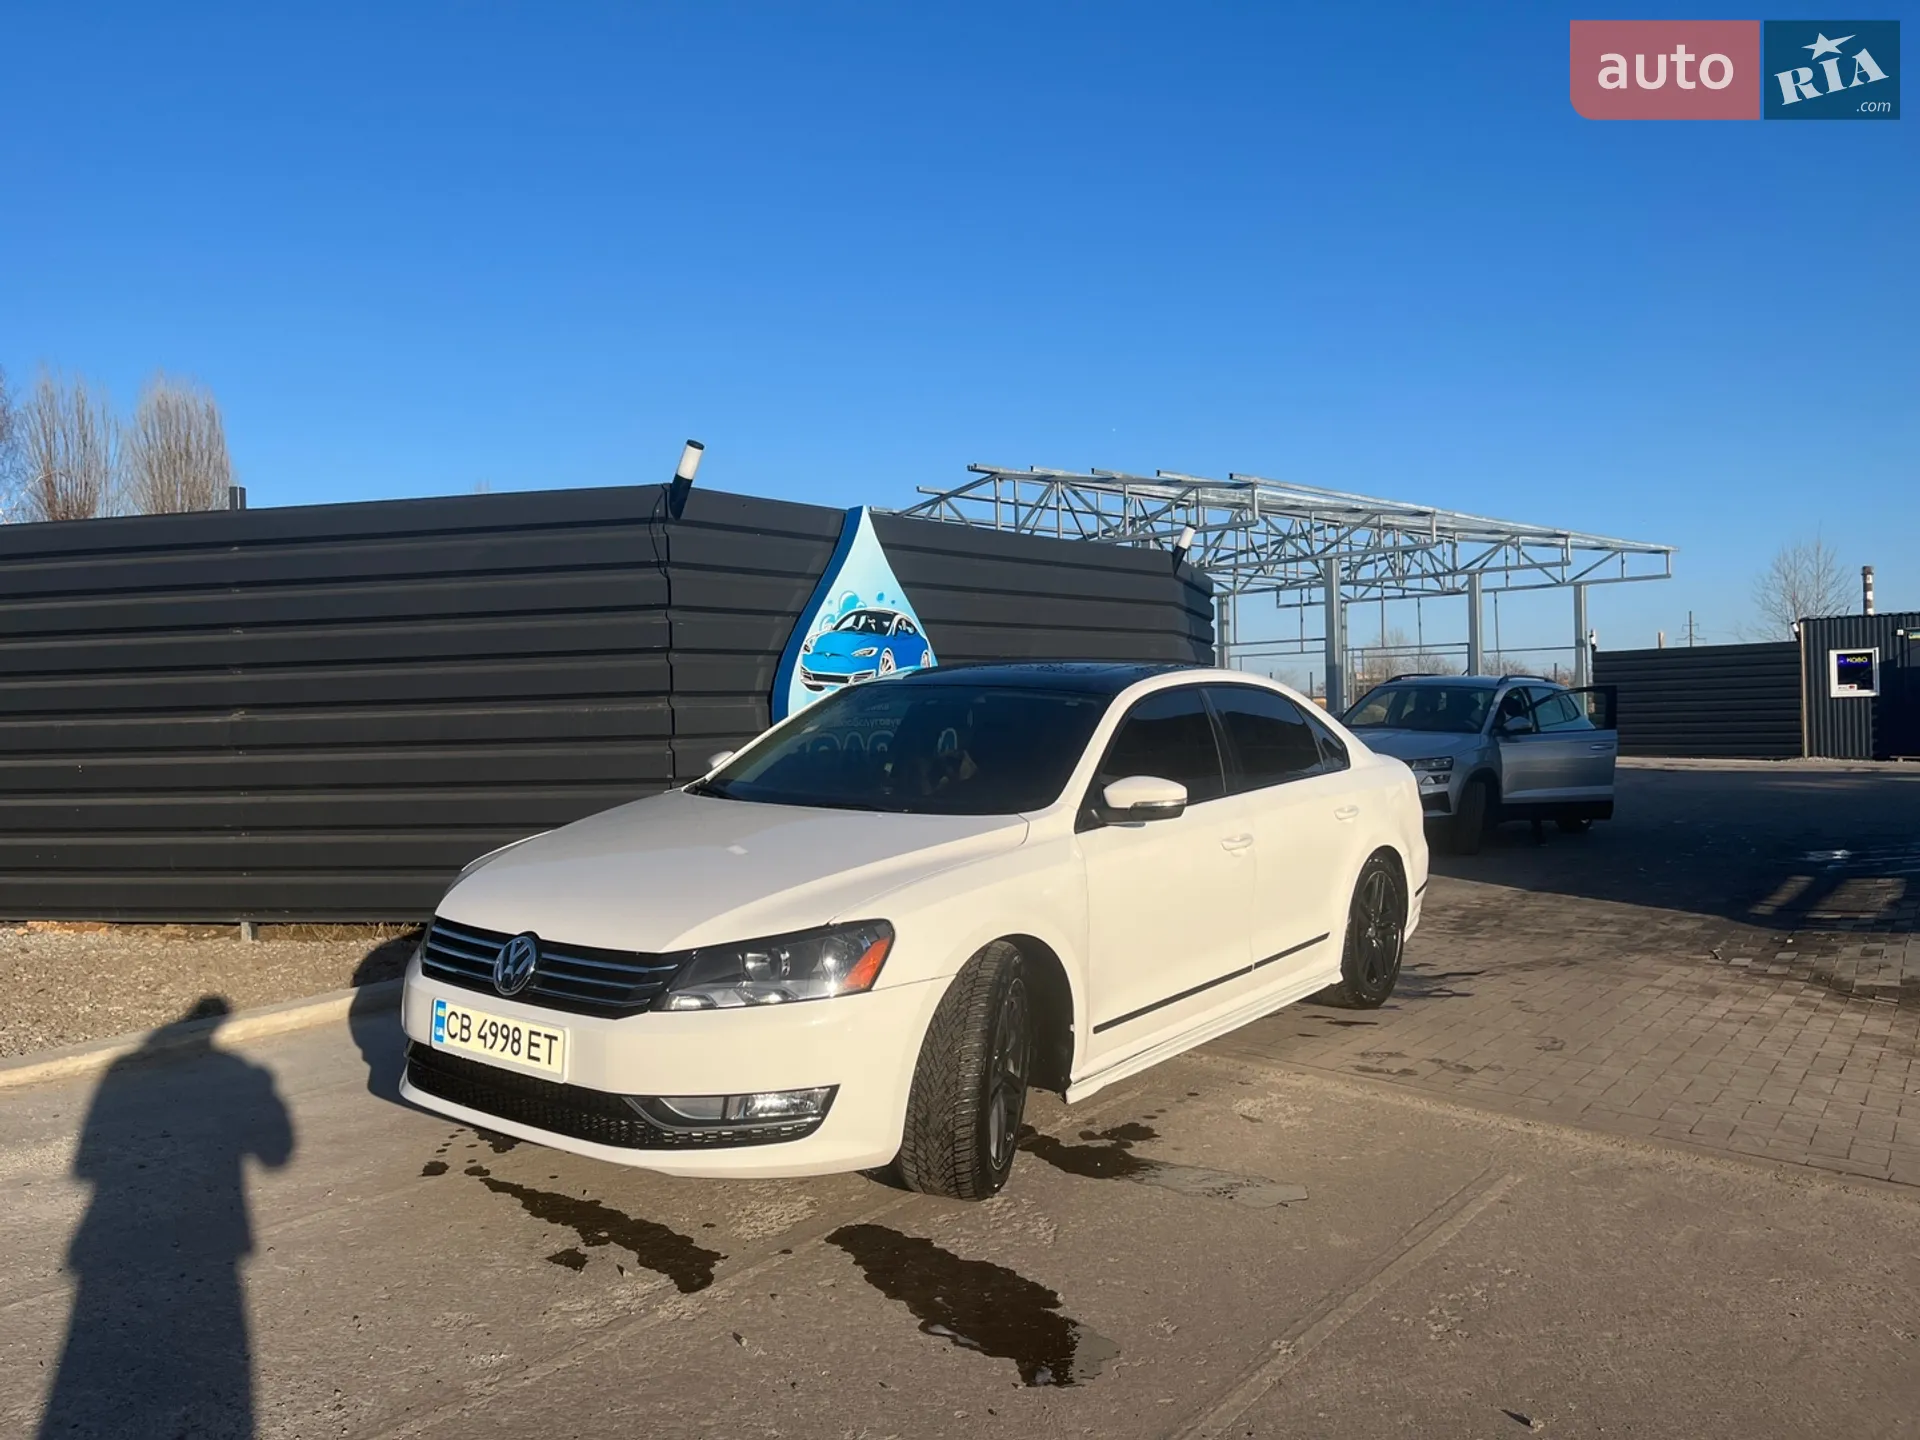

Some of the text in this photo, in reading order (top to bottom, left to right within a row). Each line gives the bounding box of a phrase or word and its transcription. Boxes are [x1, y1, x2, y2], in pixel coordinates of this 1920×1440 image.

[446, 1011, 558, 1065] CB 4998 ET
